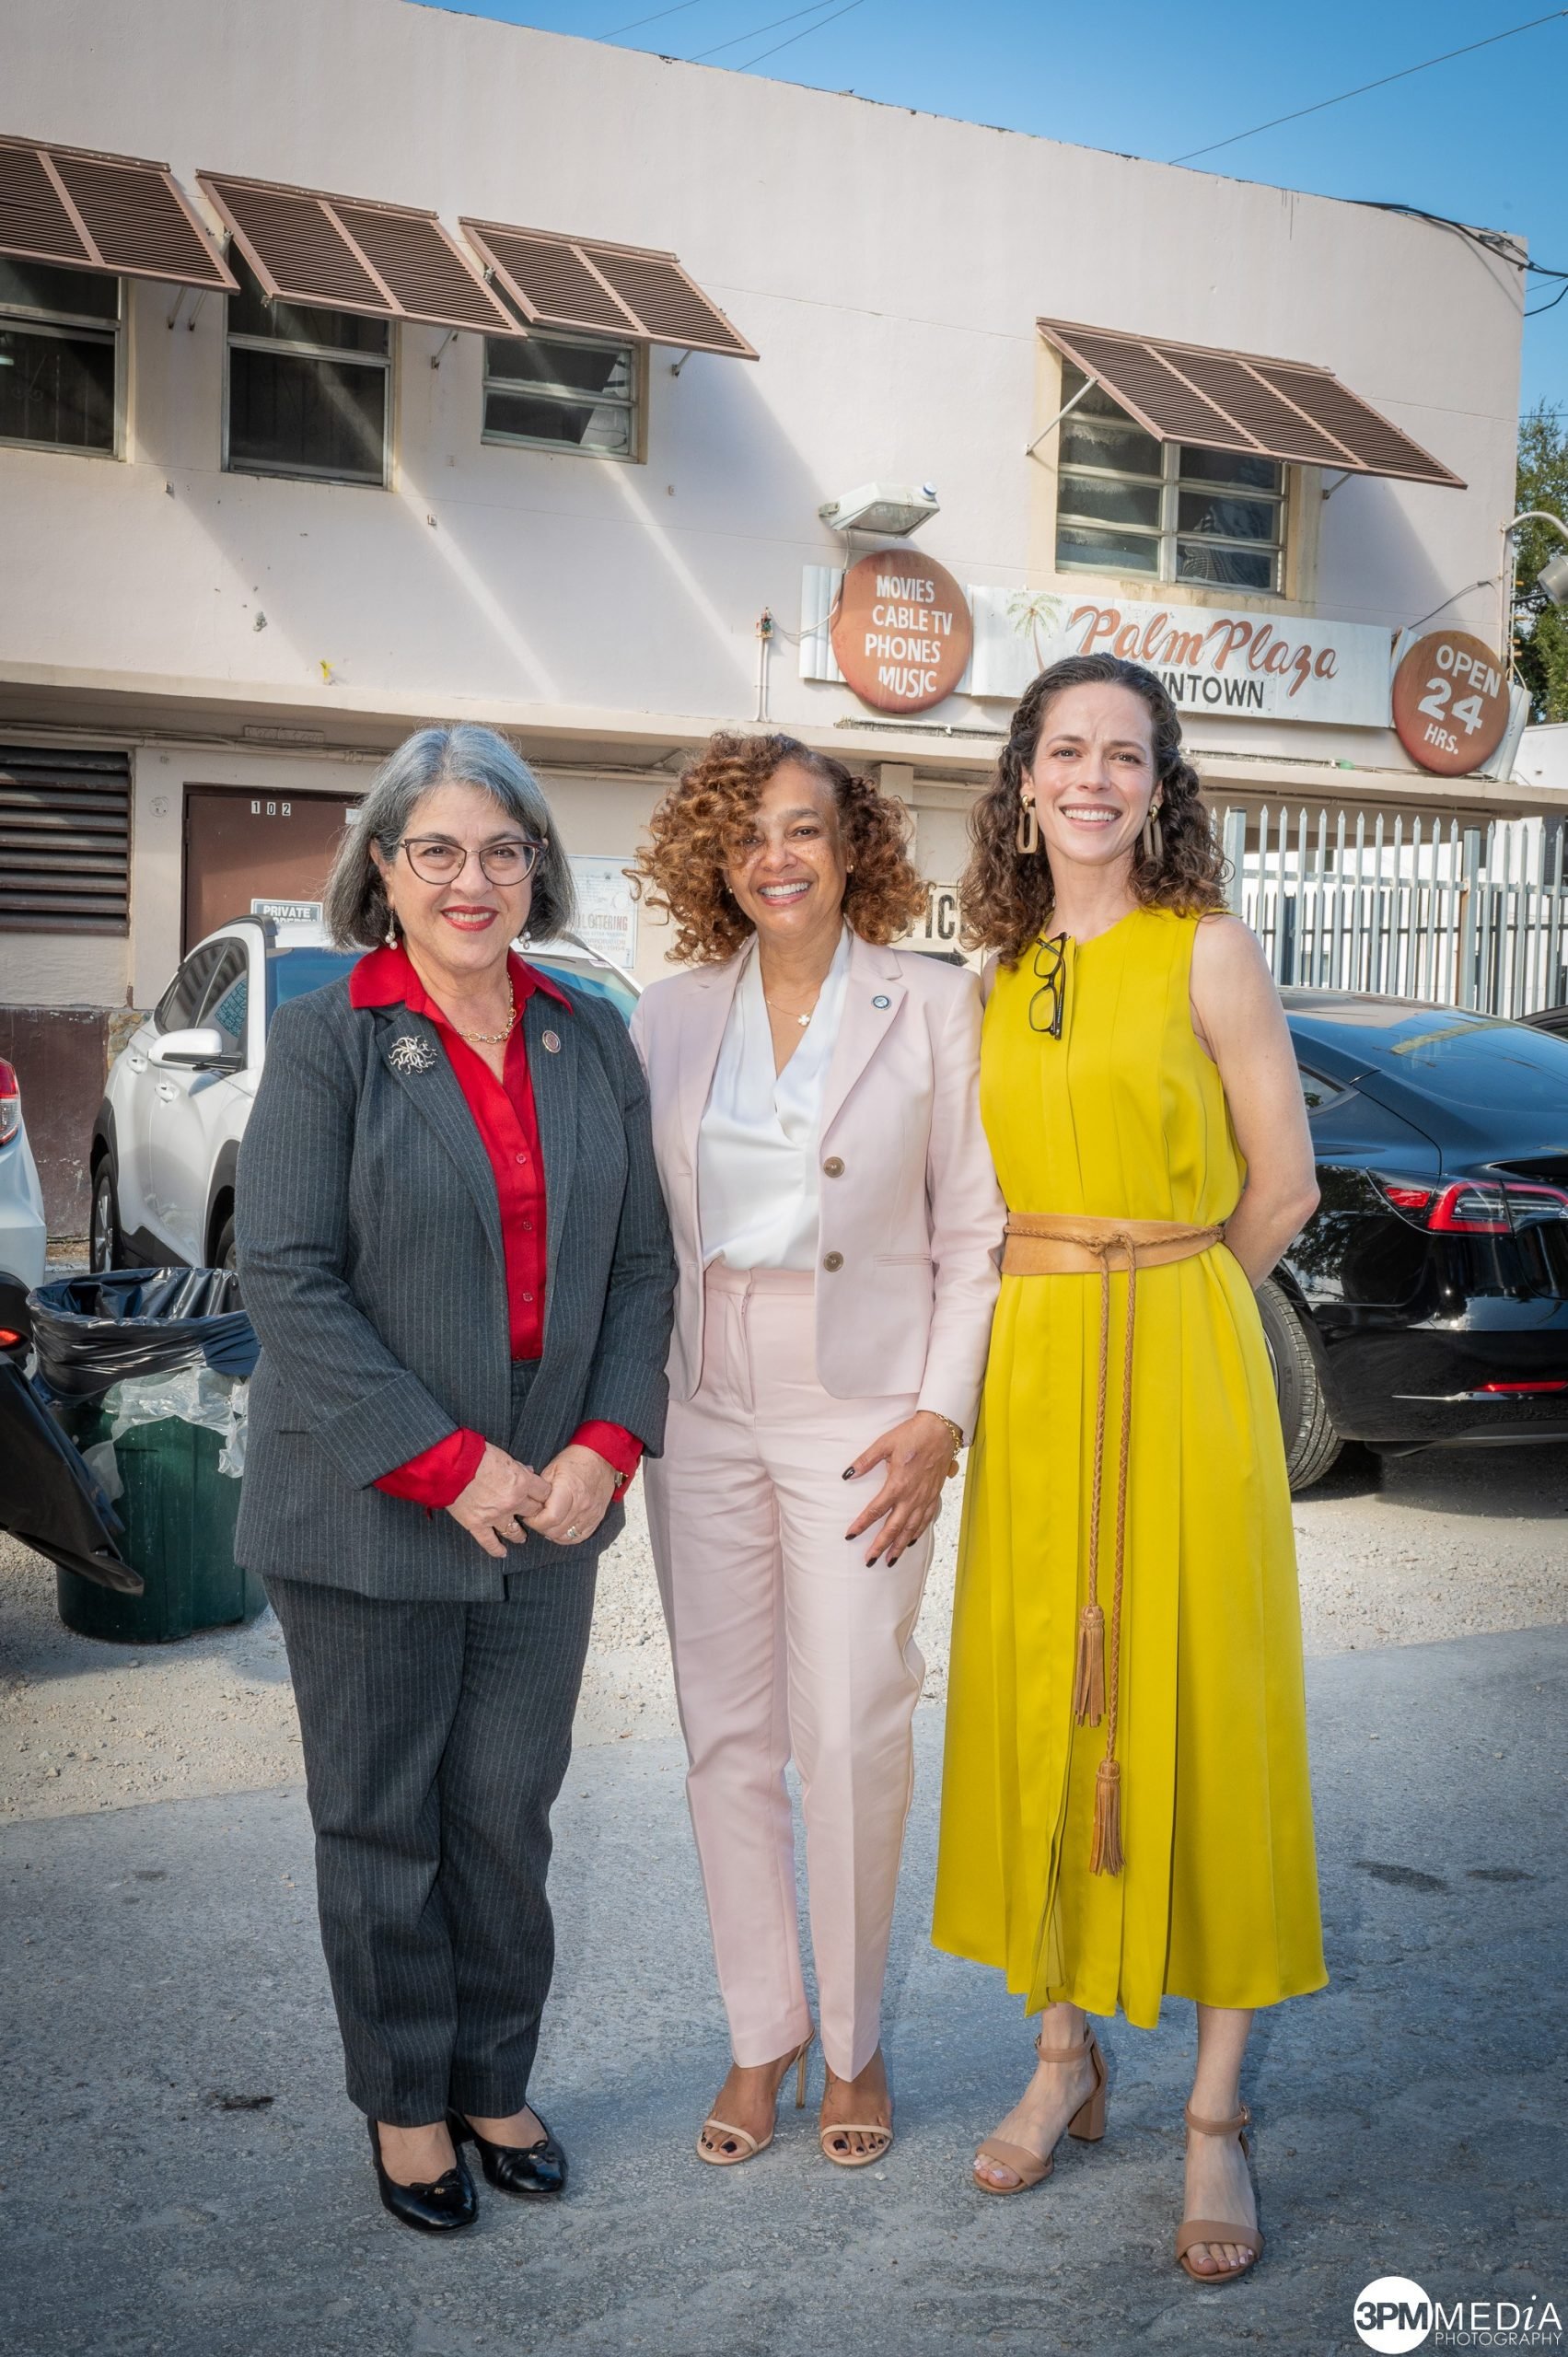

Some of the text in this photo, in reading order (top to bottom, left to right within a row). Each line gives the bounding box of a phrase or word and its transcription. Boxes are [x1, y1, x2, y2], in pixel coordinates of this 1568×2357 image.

[877, 575, 935, 603] MOVIES
[872, 604, 953, 635] CABLE TV
[865, 633, 941, 664] PHONES
[1067, 605, 1340, 697] Palm Plaza
[878, 665, 937, 698] MUSIC
[1436, 644, 1502, 699] OPEN
[1152, 670, 1264, 708] NTOWN
[1417, 677, 1483, 735] 24
[1423, 723, 1458, 755] HRS.
[253, 802, 290, 815] 102
[262, 905, 311, 918] PRIVATE
